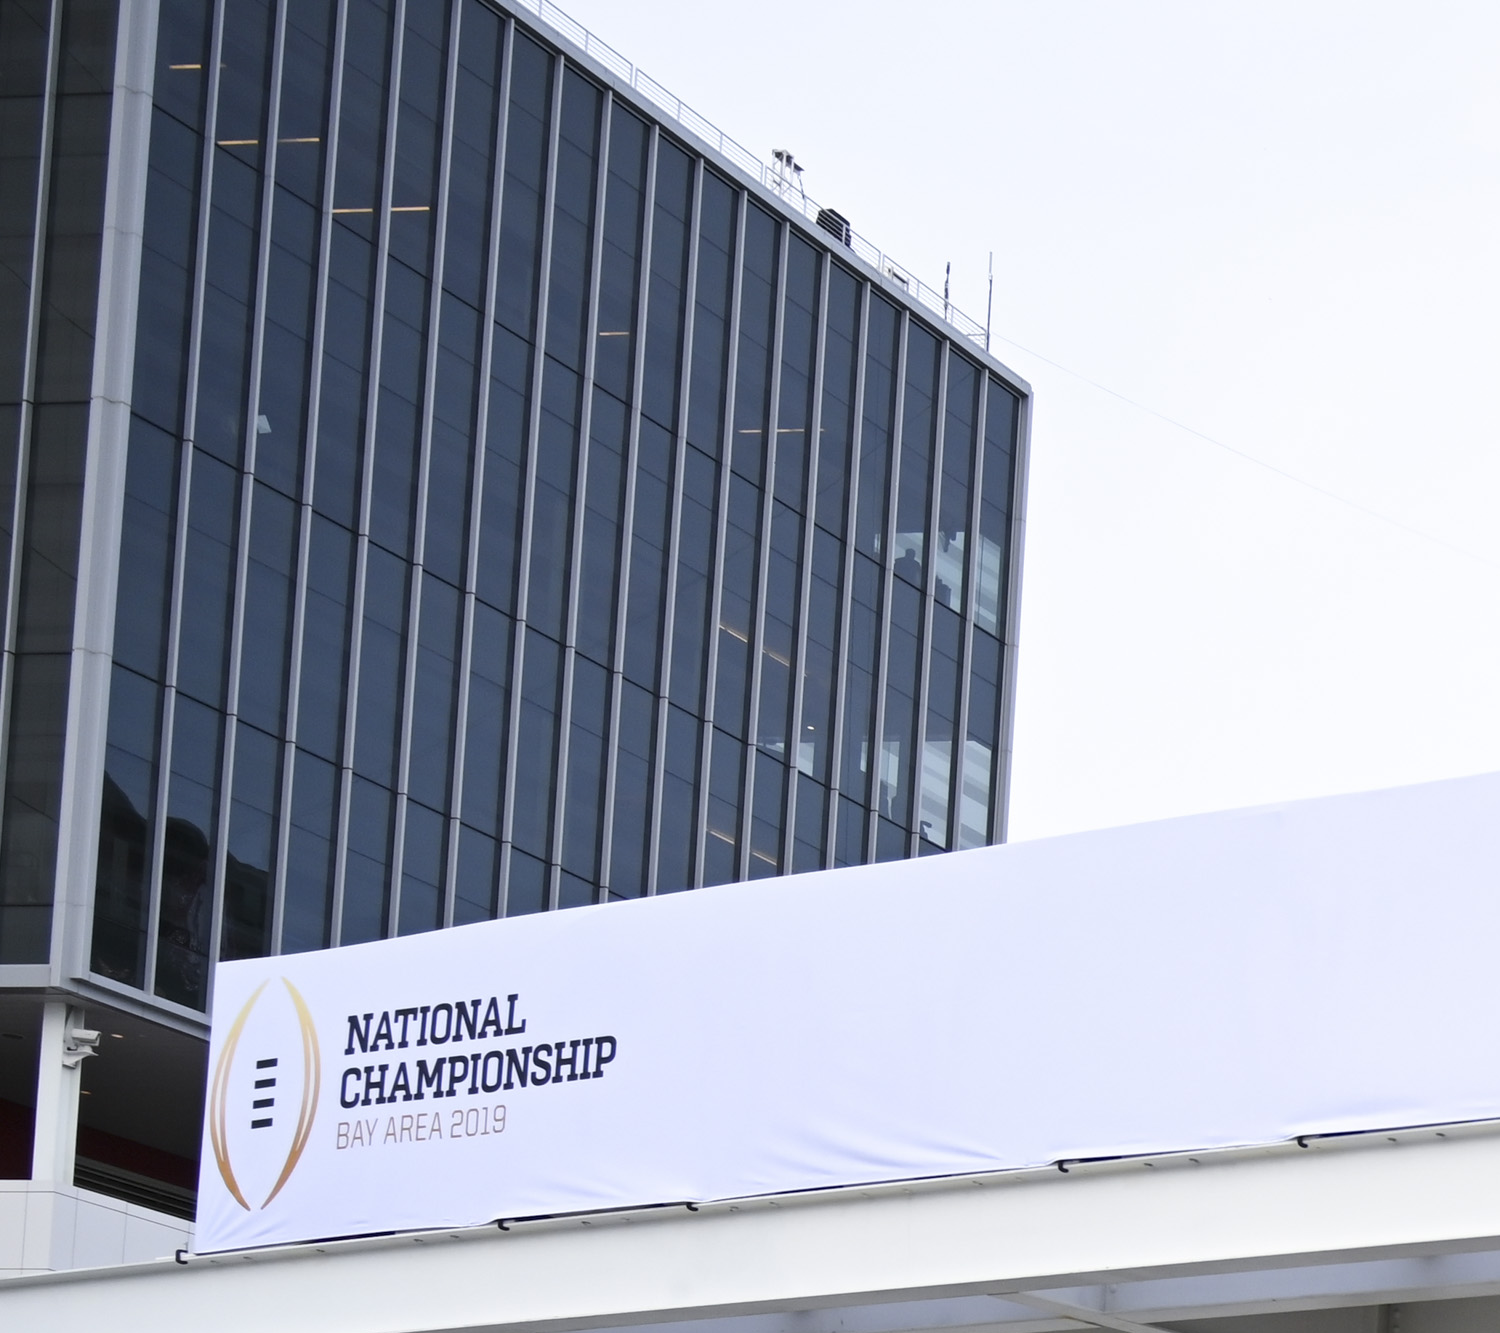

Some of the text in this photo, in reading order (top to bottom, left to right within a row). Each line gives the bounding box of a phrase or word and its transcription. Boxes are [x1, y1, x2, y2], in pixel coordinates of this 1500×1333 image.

[344, 993, 527, 1056] NATIONAL
[339, 1035, 618, 1109] CHAMPIONSHIP
[336, 1104, 507, 1150] BAY AREA 2019
